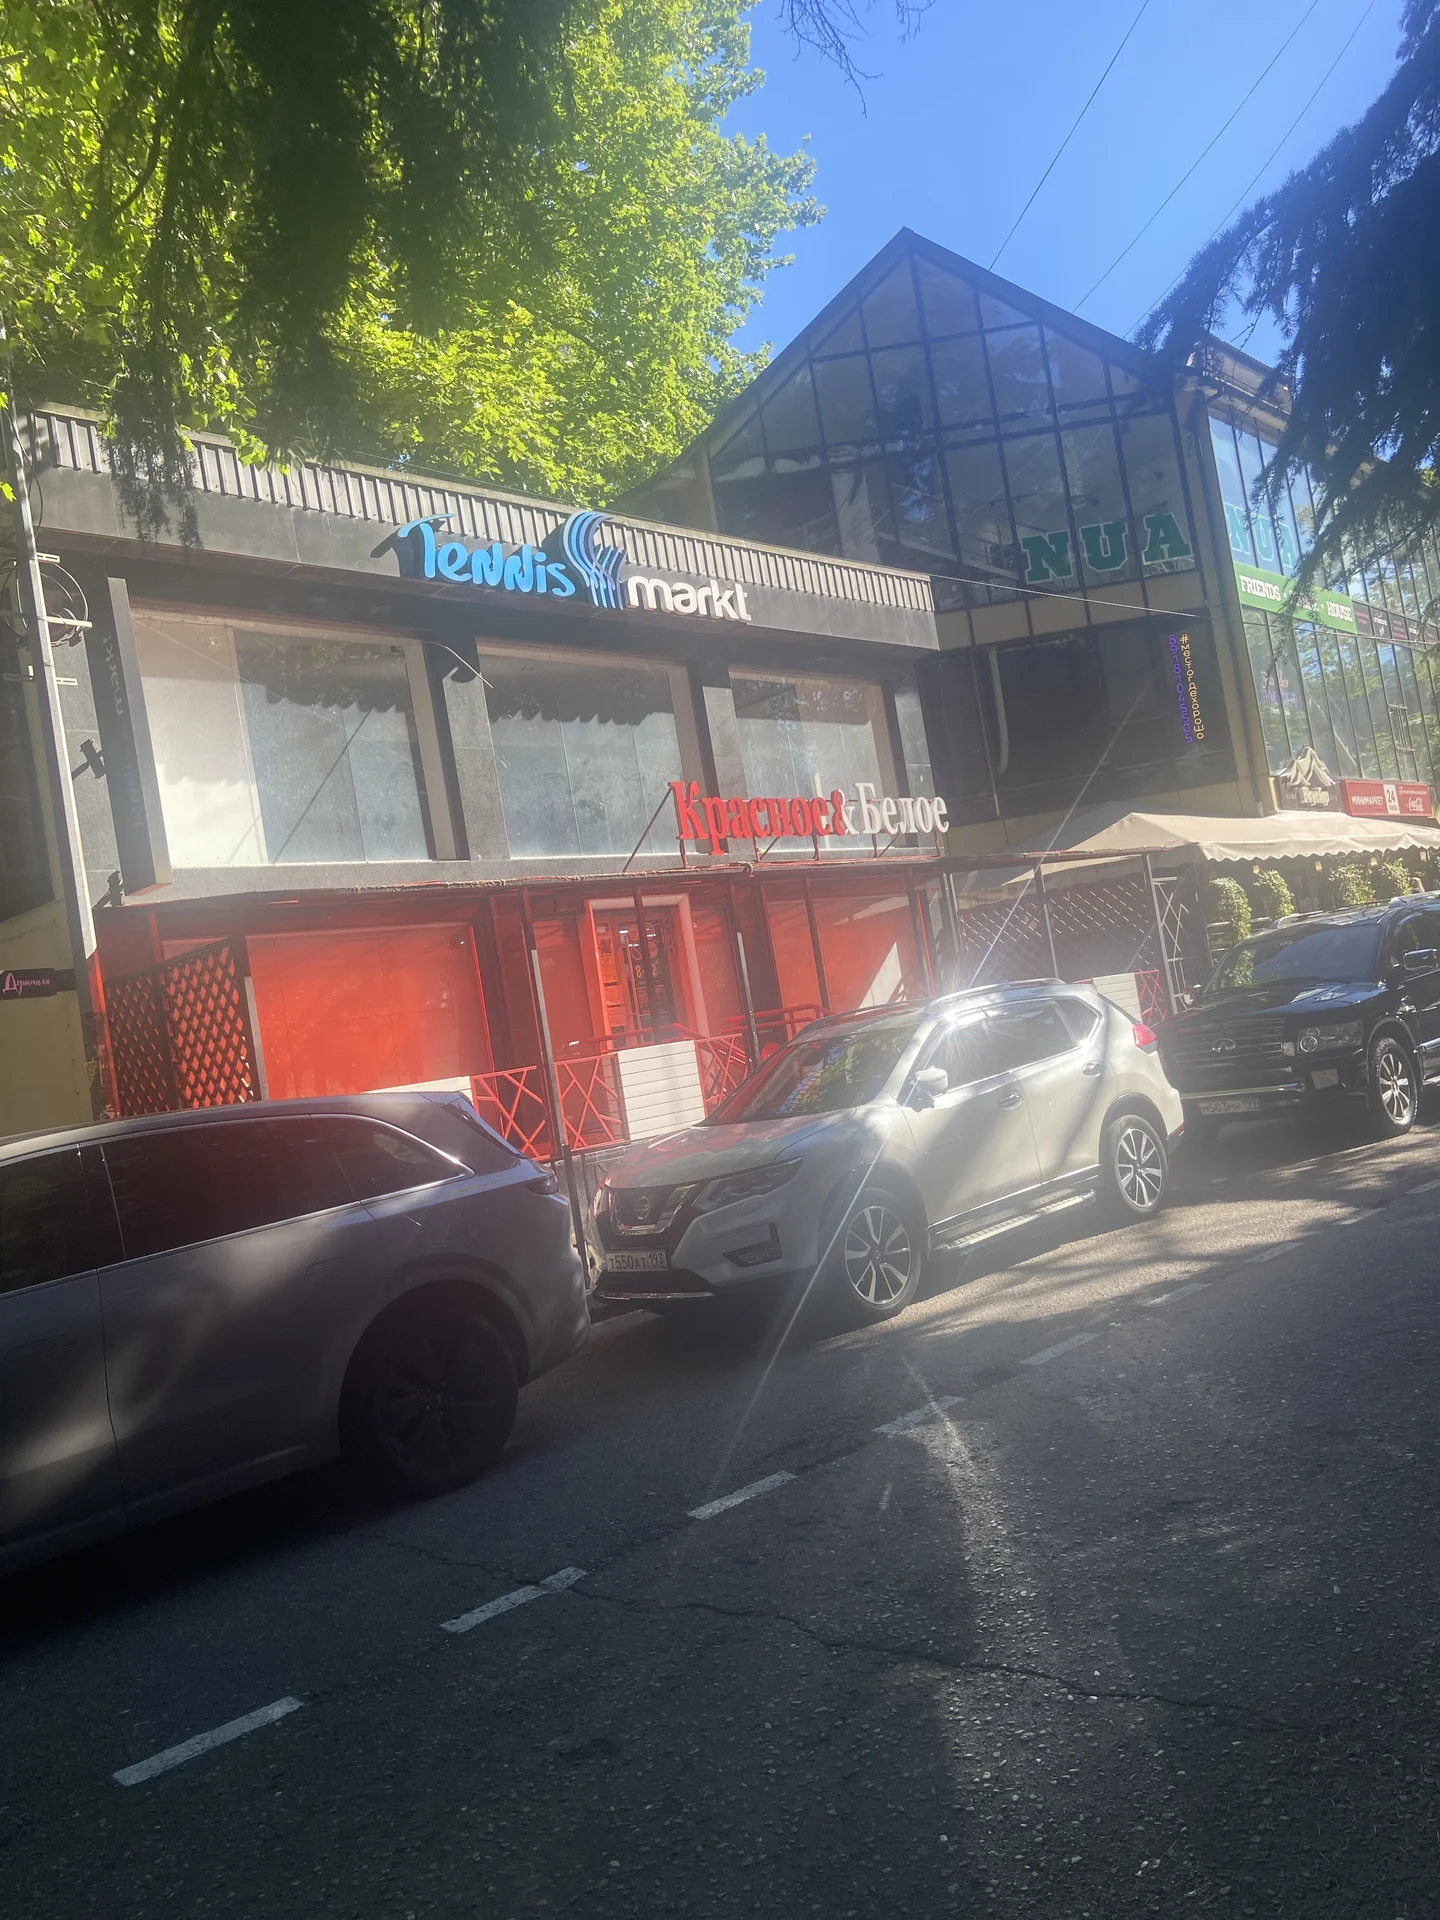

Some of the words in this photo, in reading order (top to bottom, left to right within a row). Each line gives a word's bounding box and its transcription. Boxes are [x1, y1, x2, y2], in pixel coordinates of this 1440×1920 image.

[1021, 511, 1193, 585] NUA
[626, 574, 752, 622] markt
[1239, 574, 1282, 601] FRIENDS
[1326, 600, 1353, 623] HOUSE
[102, 632, 125, 716] markt
[1386, 789, 1397, 803] 24
